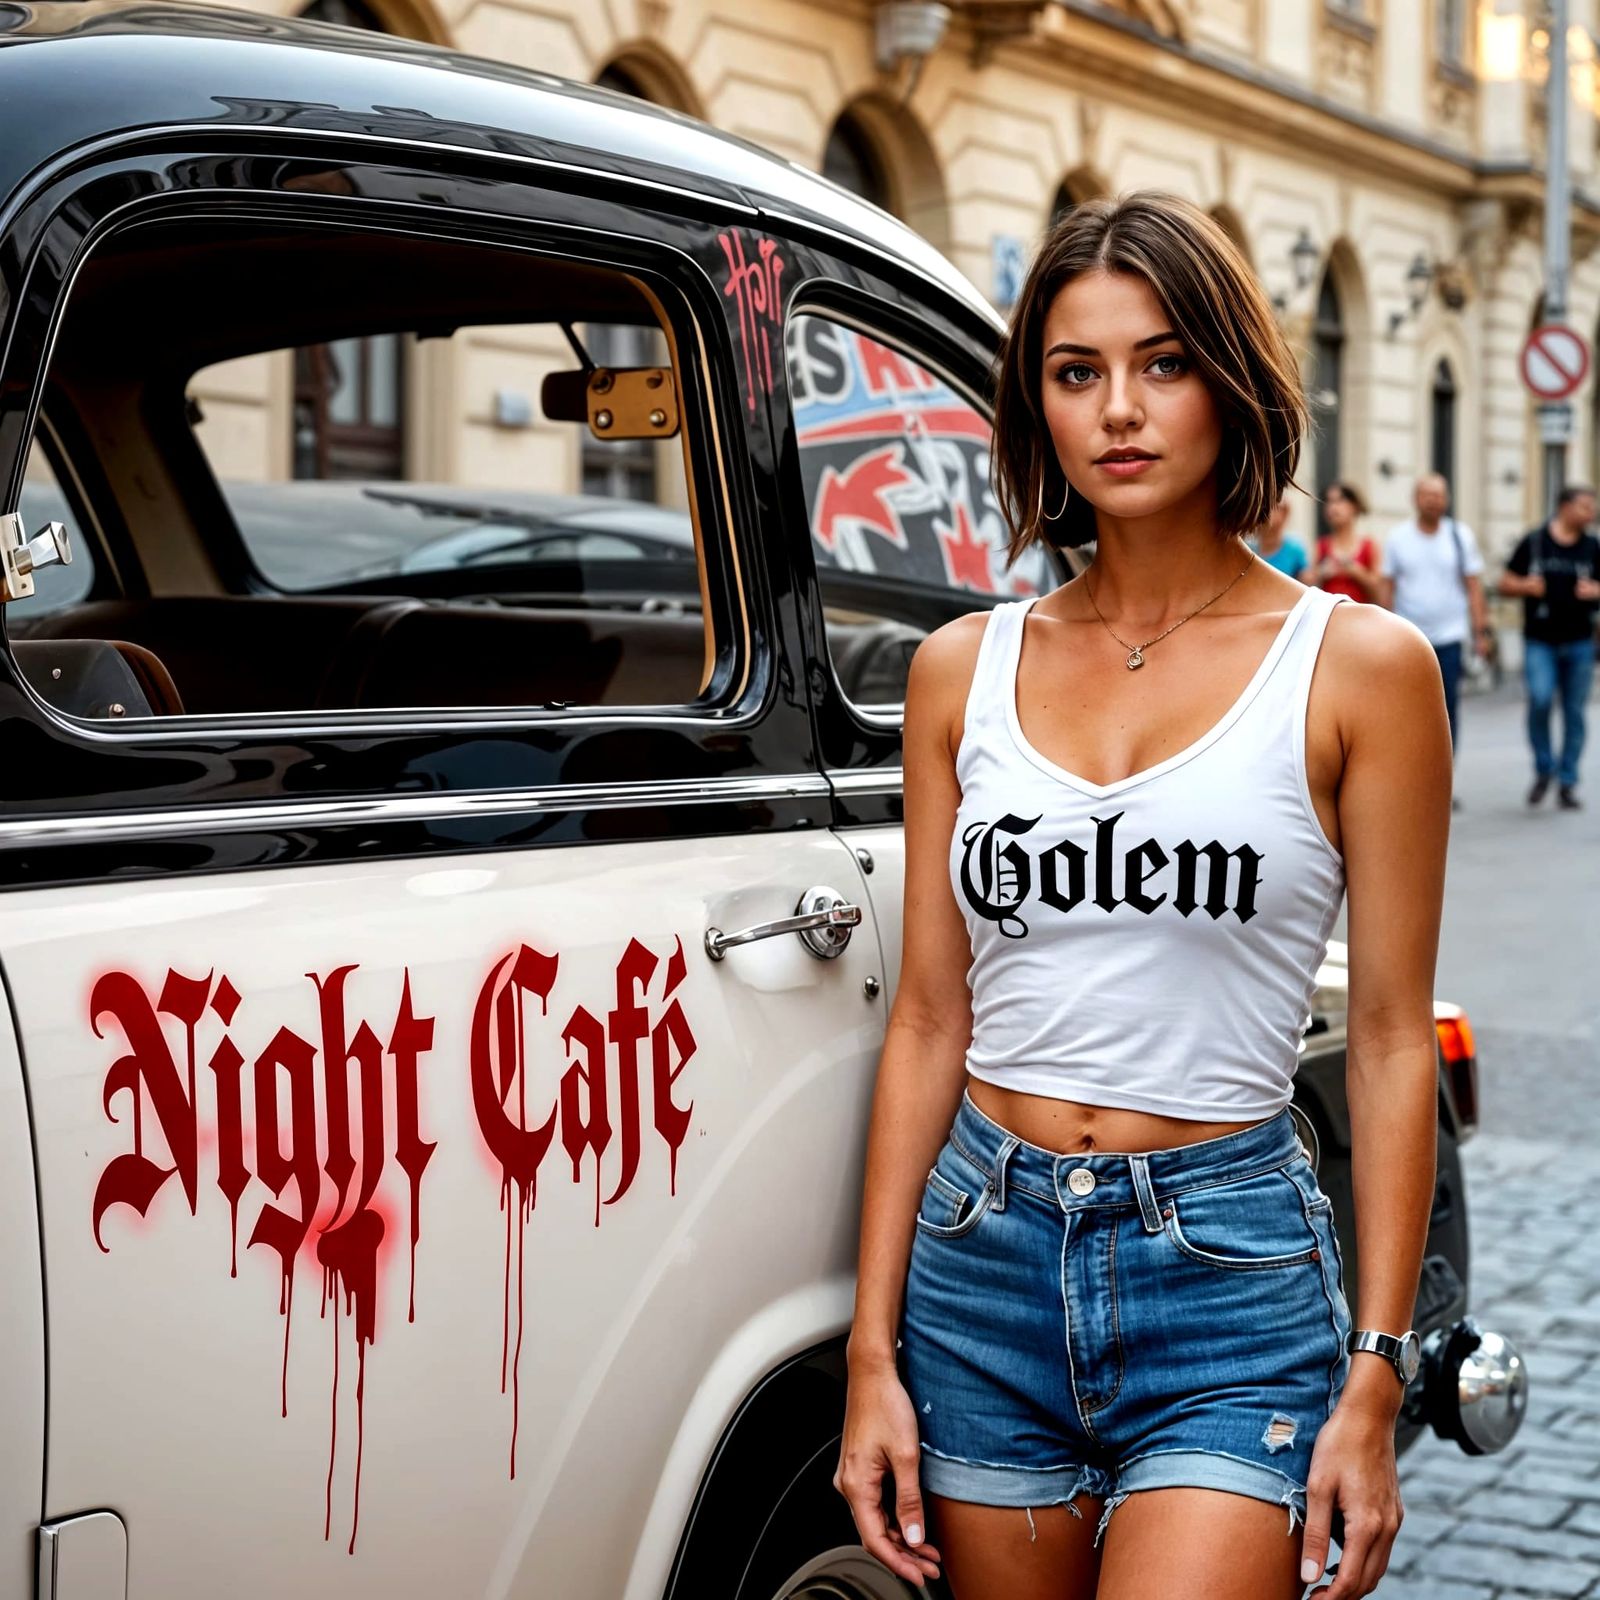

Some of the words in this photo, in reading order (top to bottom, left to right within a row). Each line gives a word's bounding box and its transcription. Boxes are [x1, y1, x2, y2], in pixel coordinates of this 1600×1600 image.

[960, 811, 1265, 939] Golem
[90, 964, 438, 1290] Night
[470, 935, 697, 1226] Café
